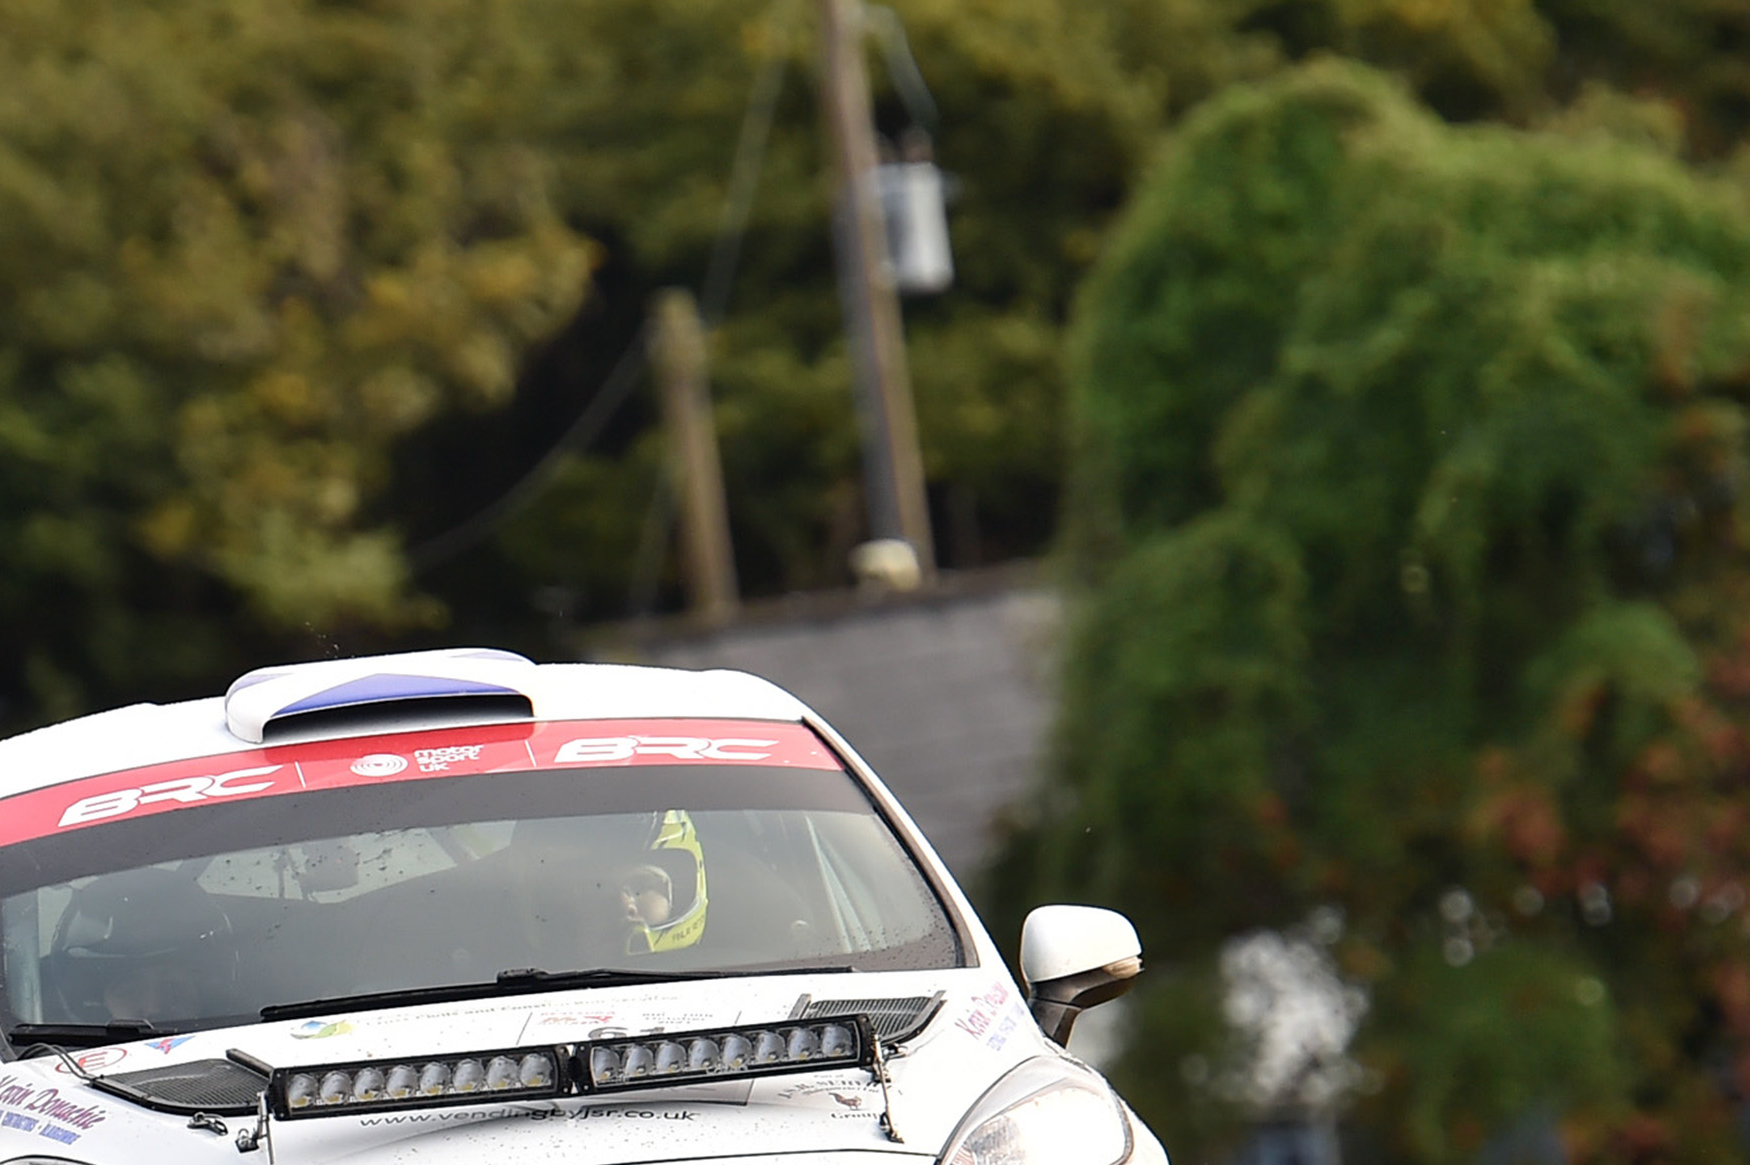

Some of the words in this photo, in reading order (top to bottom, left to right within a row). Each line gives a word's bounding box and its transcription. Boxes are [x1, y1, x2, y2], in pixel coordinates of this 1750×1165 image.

[414, 744, 484, 759] motor
[416, 753, 480, 765] sport
[554, 734, 779, 764] BRC
[58, 765, 284, 828] BRC
[360, 1106, 698, 1127] www.vendingbyjsr.co.uk
